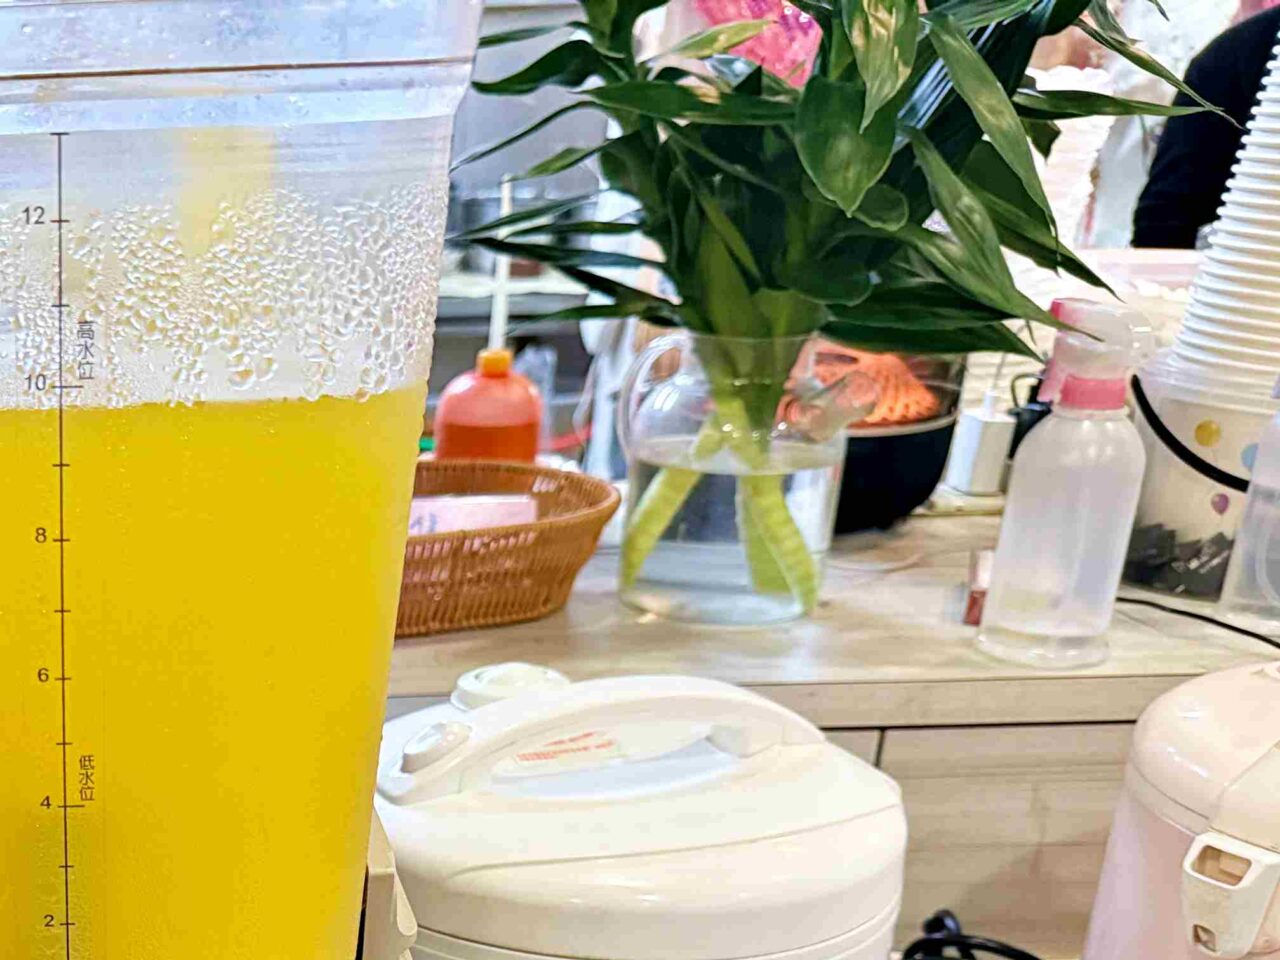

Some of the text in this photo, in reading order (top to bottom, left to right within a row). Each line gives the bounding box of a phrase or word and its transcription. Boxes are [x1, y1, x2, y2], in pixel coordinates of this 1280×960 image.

[22, 206, 45, 225] 12
[76, 320, 95, 381] 高水位
[24, 374, 47, 391] 10
[35, 527, 47, 543] 8
[37, 667, 49, 683] 6
[78, 754, 95, 801] 低水位
[39, 796, 52, 809] 4
[43, 914, 55, 928] 2
